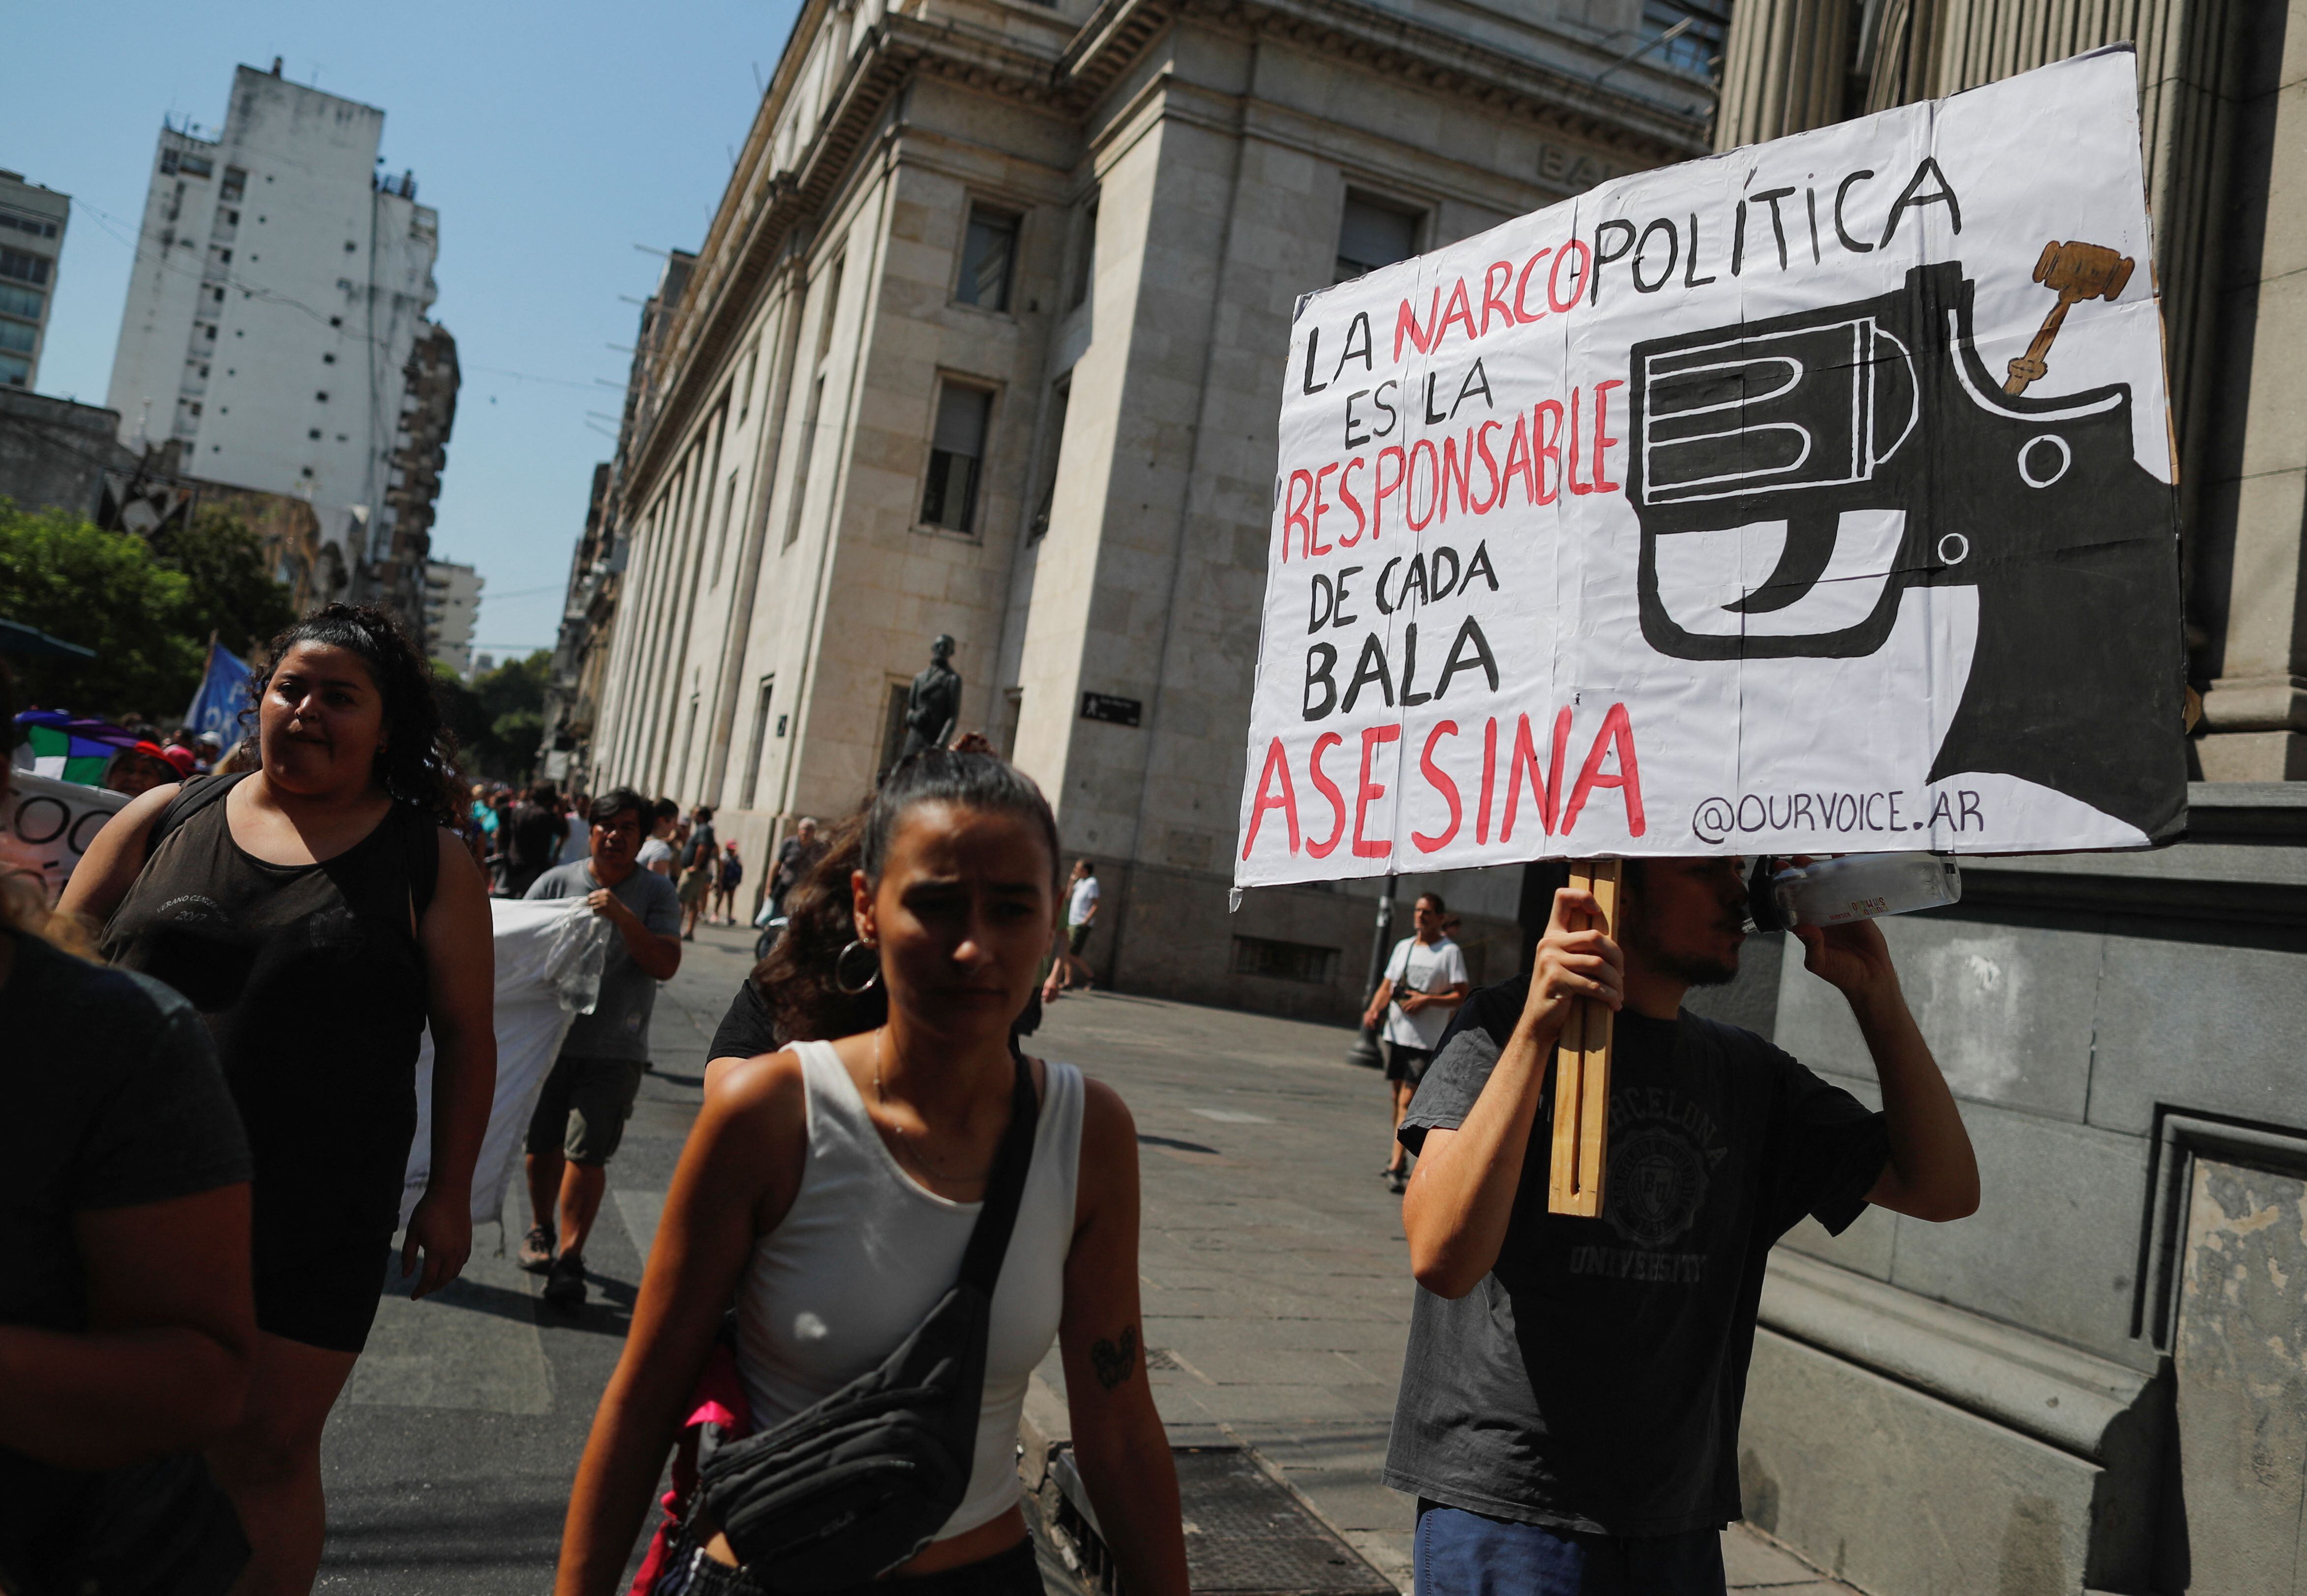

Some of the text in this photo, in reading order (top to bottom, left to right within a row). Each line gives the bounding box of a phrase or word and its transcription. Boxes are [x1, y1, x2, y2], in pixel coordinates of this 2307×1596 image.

[1304, 311, 1373, 396] LA
[1345, 357, 1494, 450] ES LA
[1282, 379, 1625, 564] RESPONSABLE
[1307, 539, 1499, 634] DE CADA
[1302, 615, 1499, 722] BALA
[1242, 702, 1646, 862] ASESINA
[1692, 789, 1984, 844] @OURVOICE.AR
[156, 895, 189, 913] VERANO
